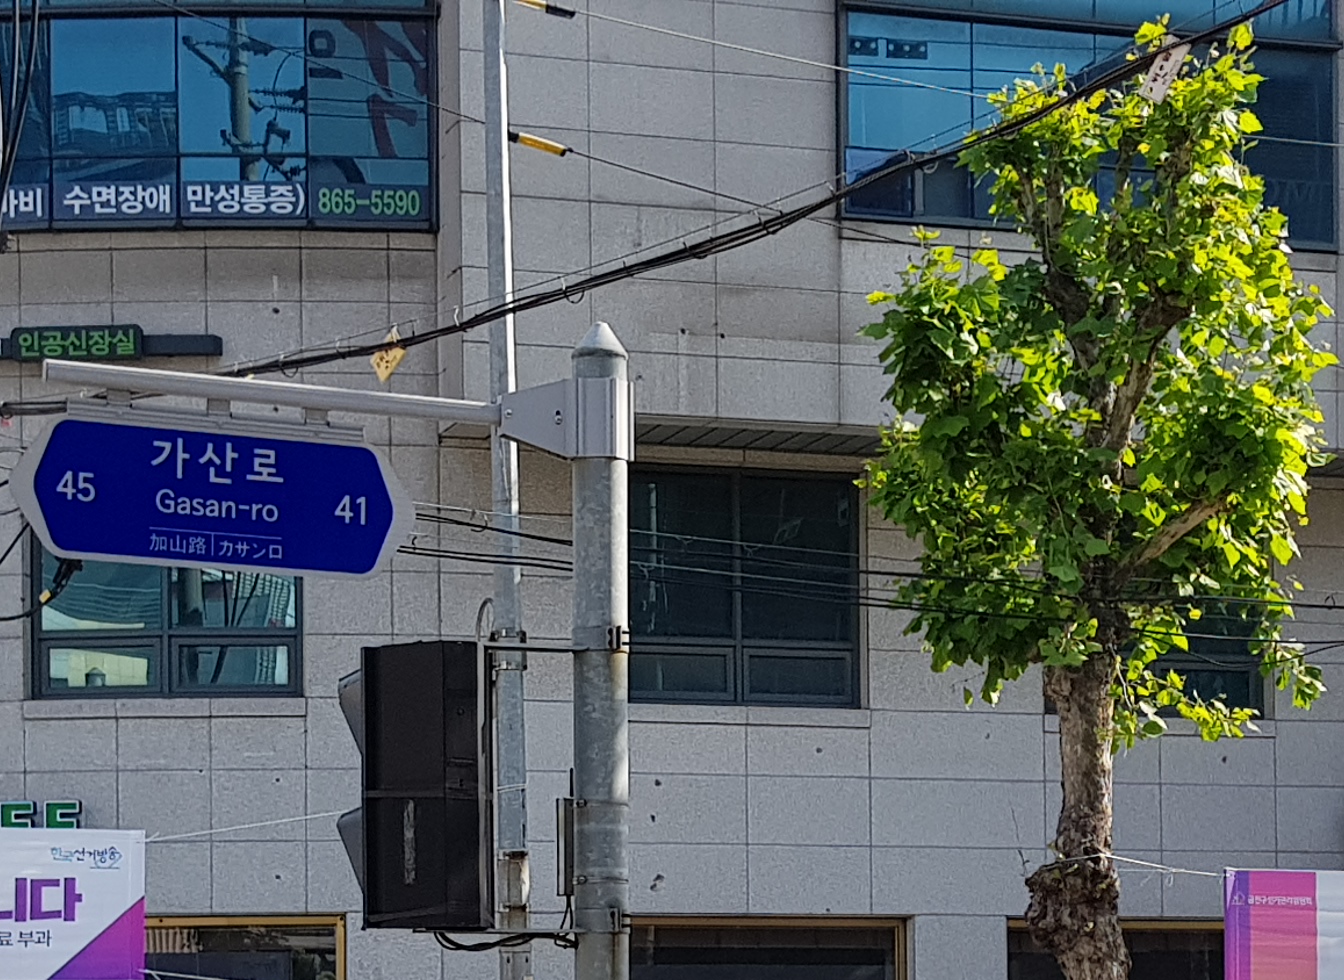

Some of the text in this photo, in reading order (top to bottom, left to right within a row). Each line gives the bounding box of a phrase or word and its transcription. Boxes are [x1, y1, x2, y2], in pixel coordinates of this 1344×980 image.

[63, 183, 172, 215] 수면장애
[186, 182, 306, 216] 만성통증)
[317, 187, 420, 216] 865-5590
[17, 327, 136, 359] 인공신장실
[150, 437, 284, 485] 가산로
[55, 470, 96, 502] 45
[156, 488, 279, 523] Gasan-ro
[334, 494, 368, 526] 41
[149, 532, 207, 555] 加山路
[219, 538, 283, 561] カサンロ
[17, 929, 53, 948] 부과
